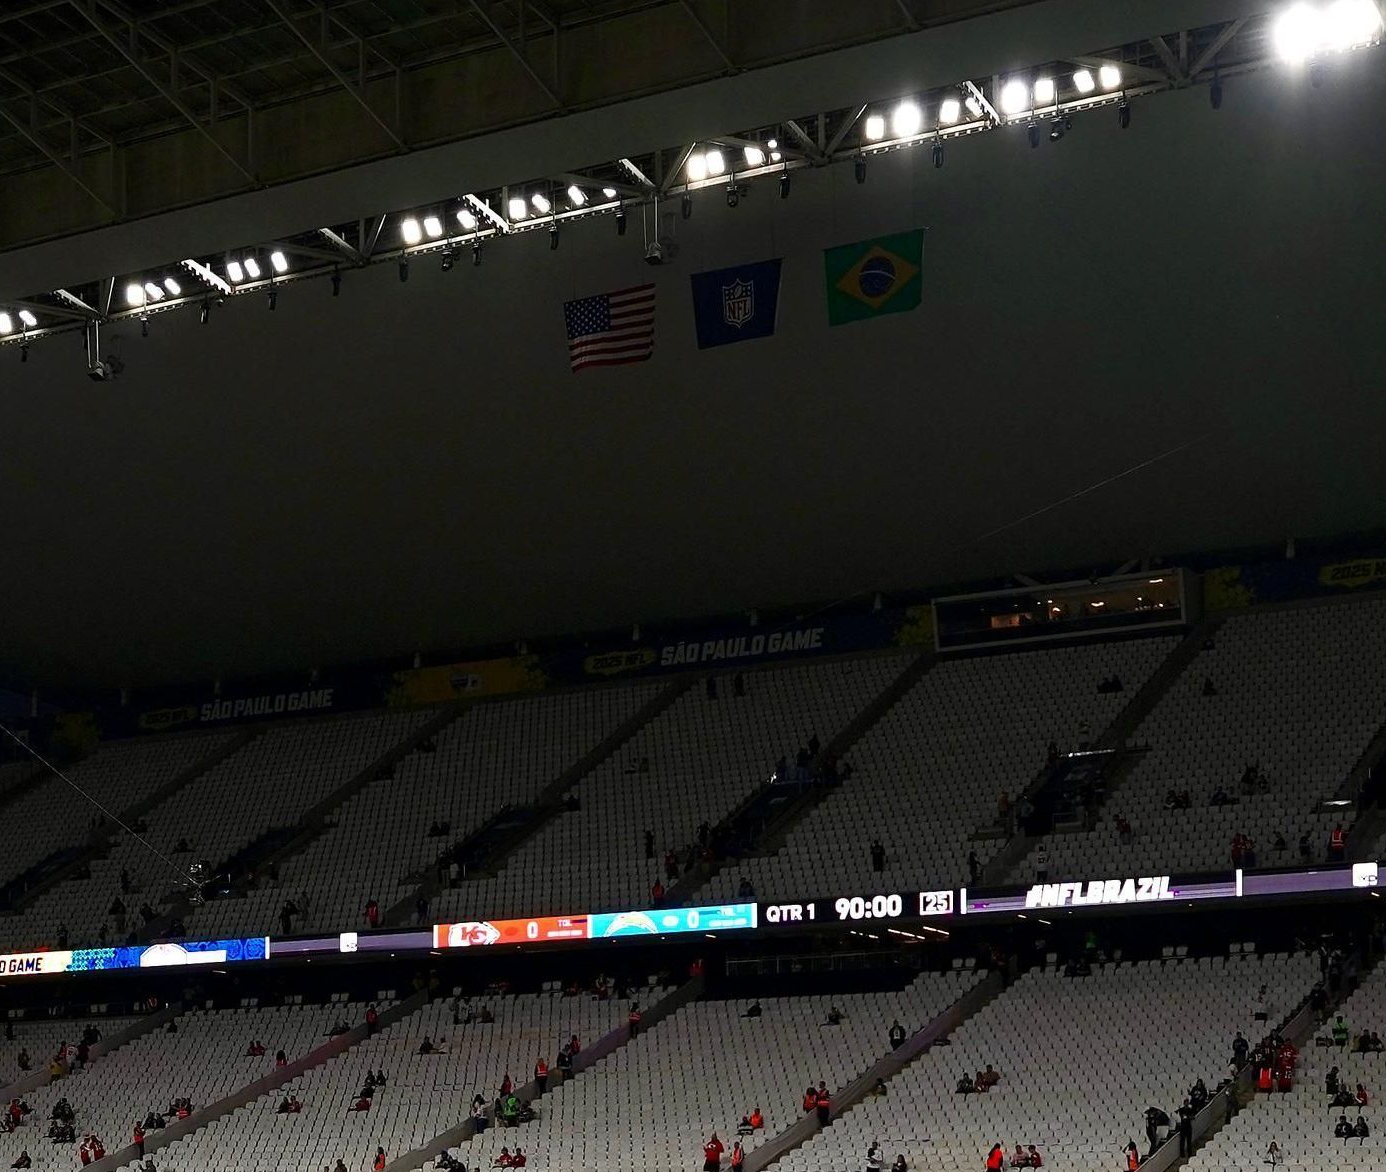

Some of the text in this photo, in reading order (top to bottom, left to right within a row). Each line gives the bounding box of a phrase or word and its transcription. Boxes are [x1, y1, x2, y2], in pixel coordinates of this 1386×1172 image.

[727, 298, 751, 319] NFL
[1331, 564, 1371, 580] 2025
[661, 641, 700, 666] SÃO
[701, 635, 765, 662] PAULO
[767, 627, 824, 654] GAME
[199, 698, 233, 722] SÃO
[233, 693, 287, 718] PAULO
[288, 688, 333, 711] GAME
[1025, 876, 1174, 908] #NFLBRAZIL
[766, 894, 948, 922] QTR 1 90:00 25
[687, 910, 700, 928] 0
[526, 921, 538, 939] 0
[8, 957, 43, 973] GAME
